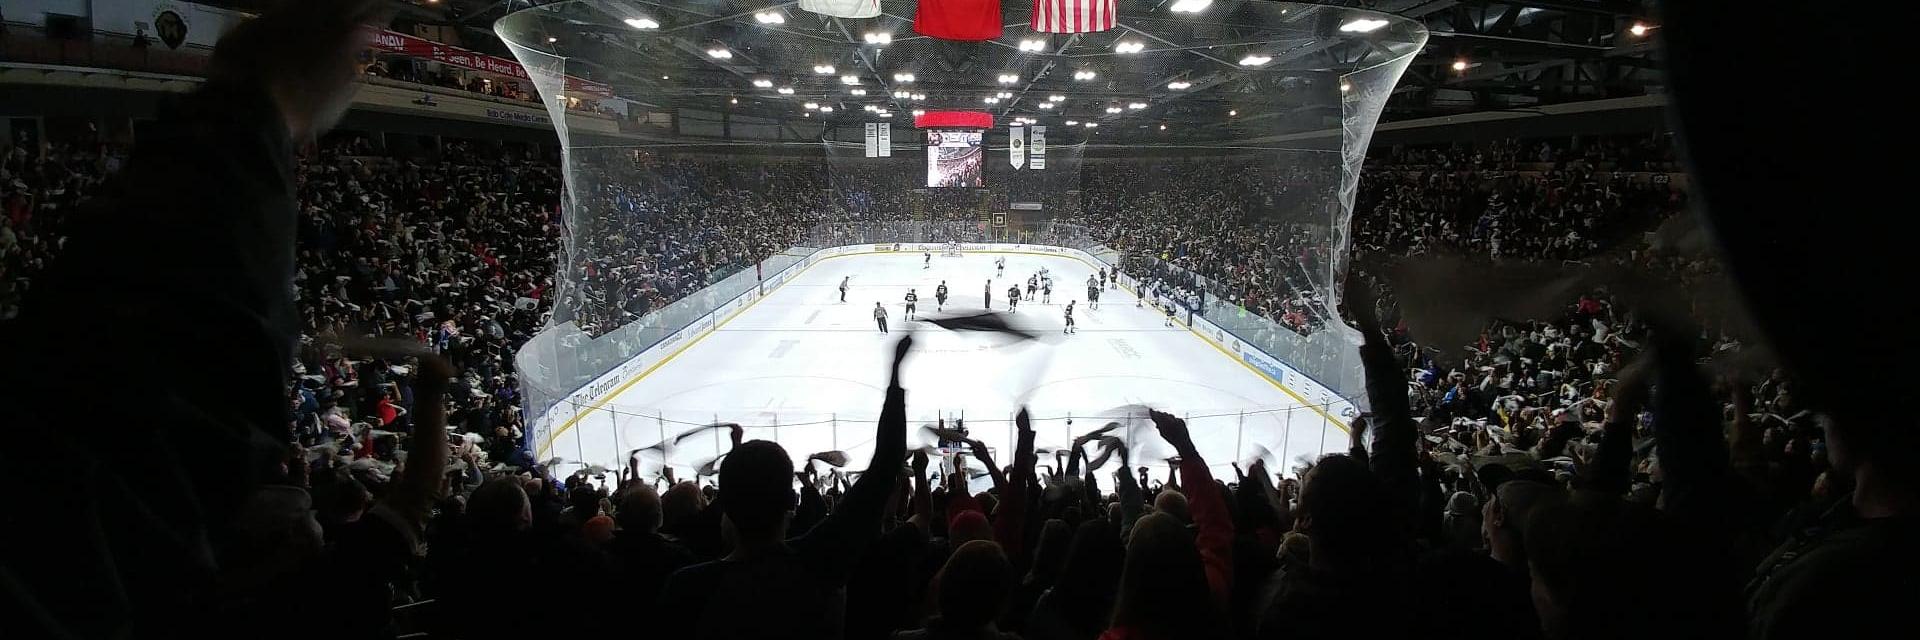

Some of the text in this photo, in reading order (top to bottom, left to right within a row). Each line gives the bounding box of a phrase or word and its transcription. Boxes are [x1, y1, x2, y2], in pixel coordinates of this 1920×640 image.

[475, 56, 486, 69] Be
[574, 374, 620, 409] The Telegram
